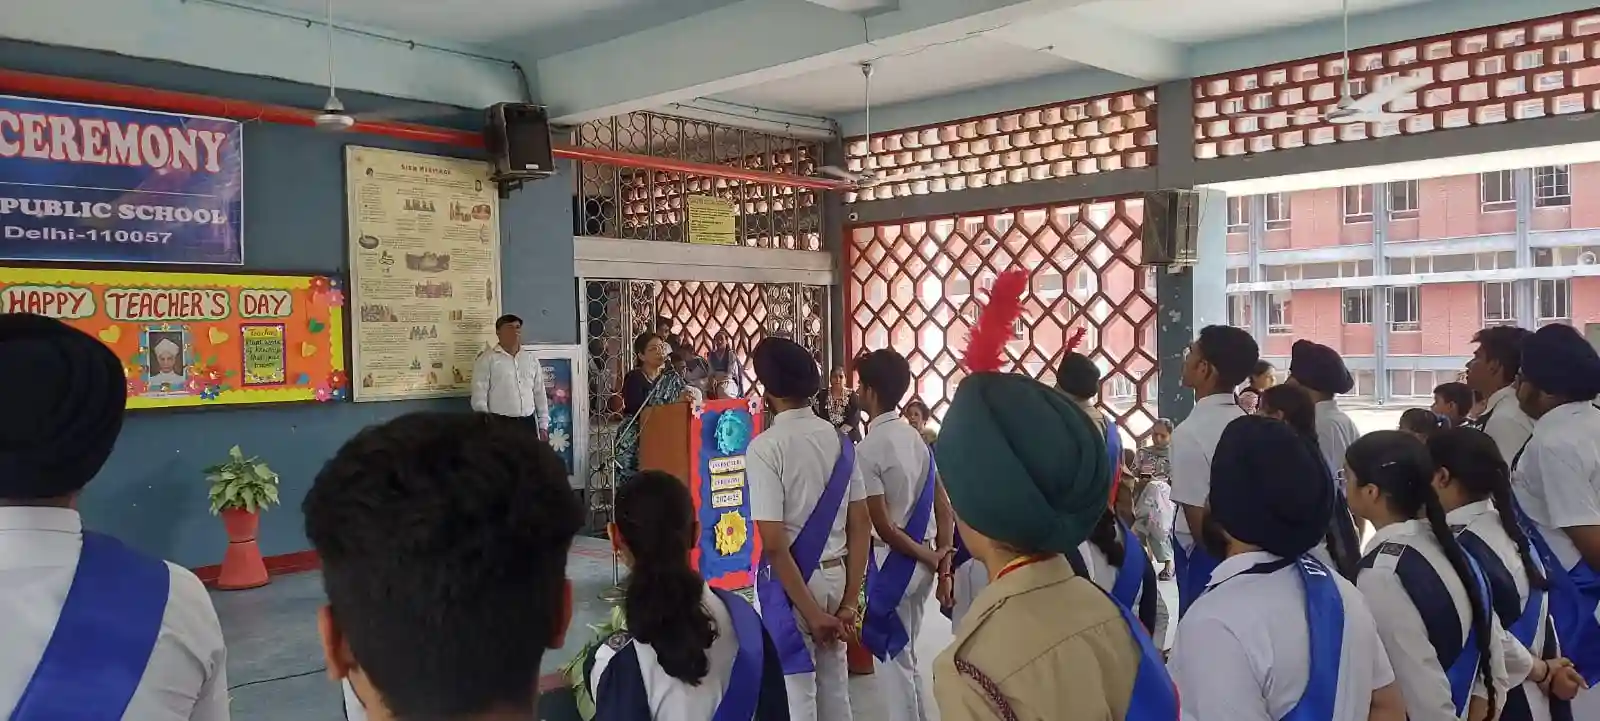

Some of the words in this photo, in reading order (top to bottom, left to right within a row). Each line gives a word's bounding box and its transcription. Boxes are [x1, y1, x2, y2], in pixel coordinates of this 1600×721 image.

[0, 110, 226, 173] CEREMONY
[0, 198, 112, 219] PUBLIC
[118, 203, 227, 224] SCHOOL
[5, 225, 173, 244] Delhi-110057
[9, 290, 87, 315] HAPPY
[108, 291, 227, 318] TEACHER'S
[243, 294, 287, 316] DAY
